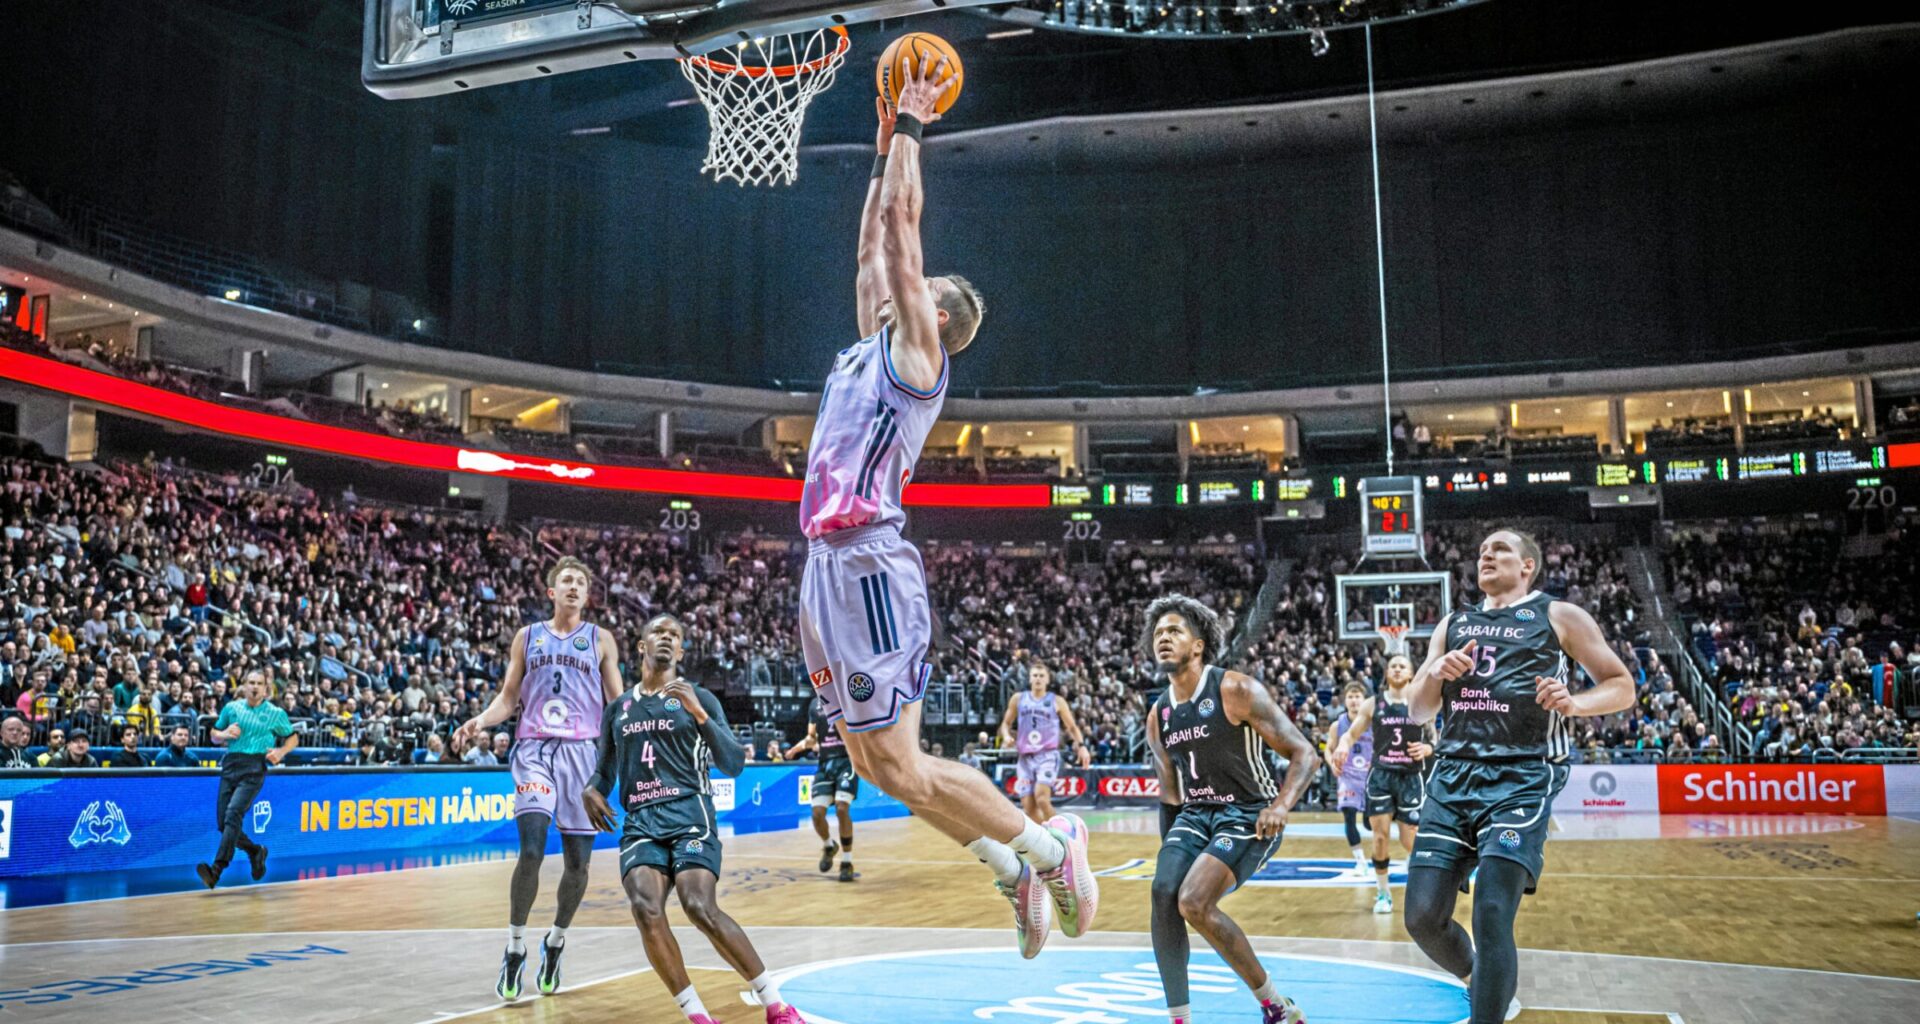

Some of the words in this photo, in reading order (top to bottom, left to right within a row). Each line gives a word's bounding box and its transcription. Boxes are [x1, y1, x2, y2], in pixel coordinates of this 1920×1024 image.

[1847, 485, 1896, 509] 220
[660, 508, 700, 531] 203
[1063, 520, 1101, 540] 202
[1382, 511, 1408, 532] 21
[1457, 625, 1501, 638] SABAH
[1504, 627, 1524, 639] BC
[530, 655, 553, 670] ALBA
[556, 654, 591, 675] BERLIN
[1469, 645, 1496, 677] 15
[552, 671, 562, 694] 3
[1461, 687, 1491, 699] Bank
[622, 720, 655, 736] SABAH
[658, 719, 675, 731] BC
[1165, 728, 1192, 749] SABAH
[1193, 724, 1210, 739] BC
[1391, 728, 1402, 746] 3
[641, 740, 656, 769] 4
[1188, 751, 1199, 779] 1
[636, 778, 662, 791] Bank
[1189, 785, 1215, 797] Bank
[1683, 771, 1856, 801] Schindler
[300, 801, 330, 832] IN
[338, 797, 436, 831] BESTEN
[441, 787, 515, 824] HÄNDE
[1582, 798, 1626, 807] Schindler
